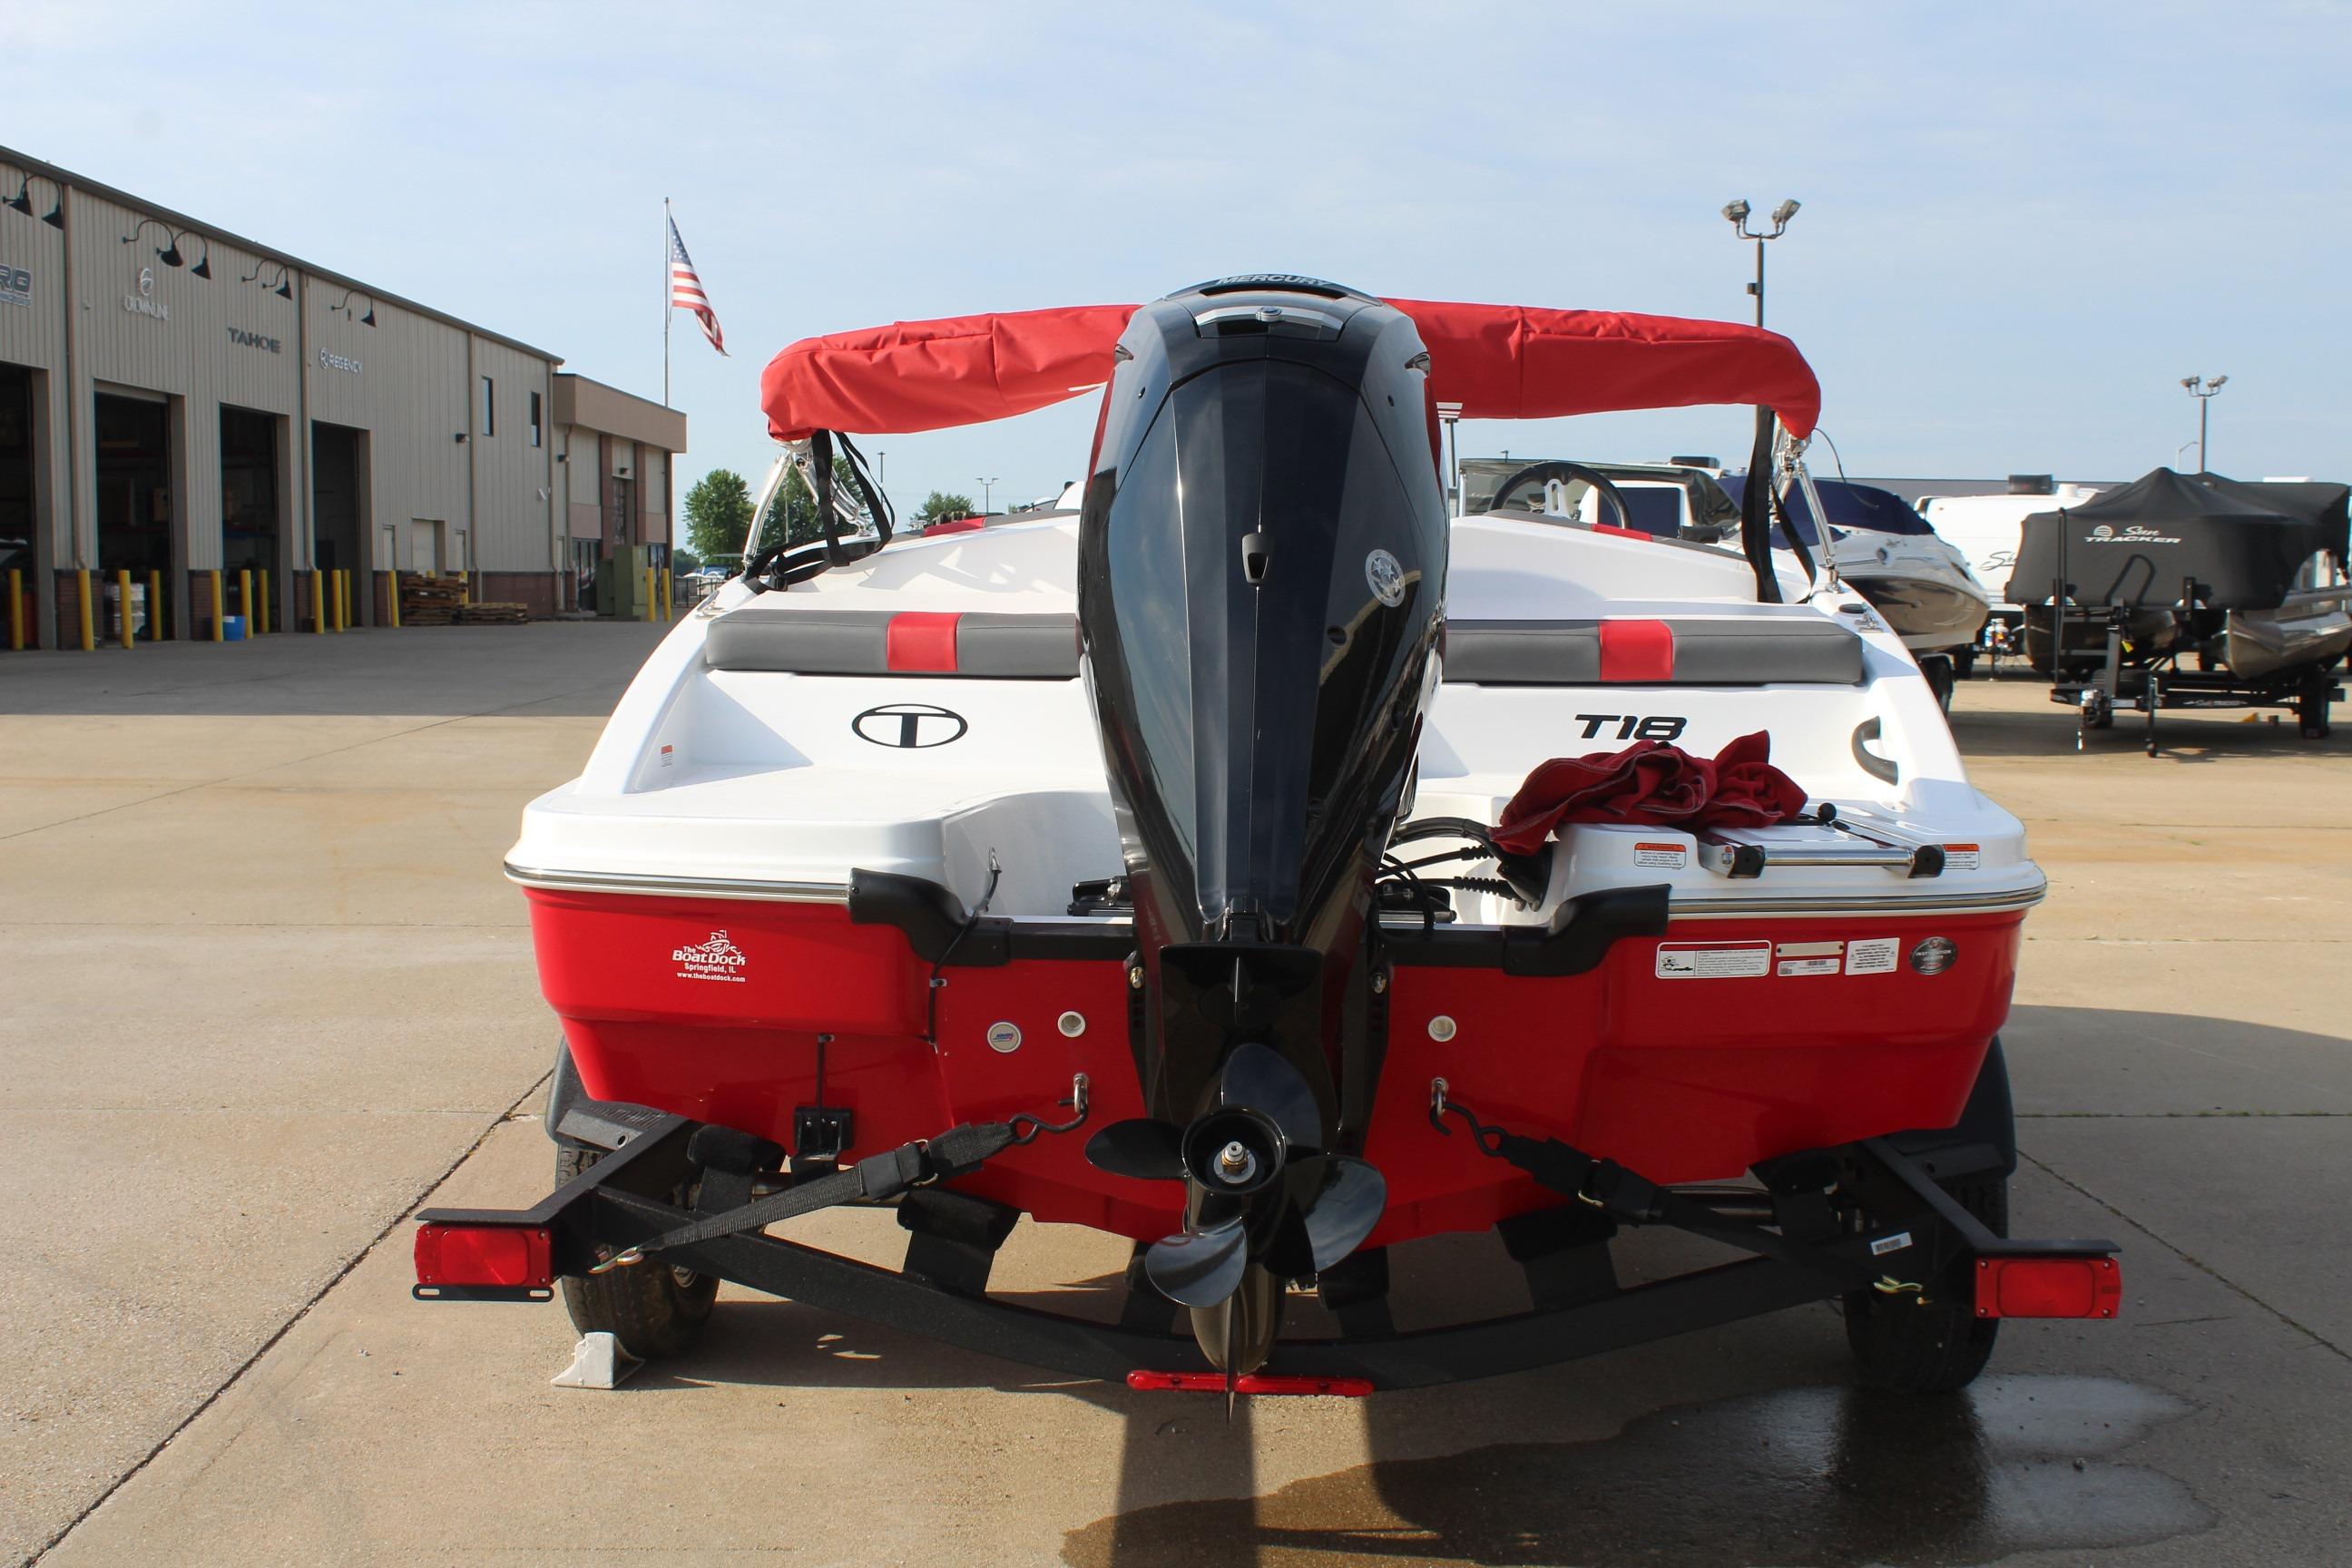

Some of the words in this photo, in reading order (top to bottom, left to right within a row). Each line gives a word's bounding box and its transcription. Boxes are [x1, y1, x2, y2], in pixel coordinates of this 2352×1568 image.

[1216, 274, 1331, 286] MERCURY
[228, 327, 280, 354] TAHOE
[329, 354, 363, 377] REGENCY
[2122, 525, 2160, 536] Sun
[2084, 535, 2181, 544] TRACKER
[1574, 713, 1688, 741] T18
[682, 946, 696, 954] The
[672, 949, 708, 963] Boat
[709, 952, 746, 966] Dock
[684, 963, 727, 974] Springfield,
[729, 965, 736, 974] IL
[676, 972, 746, 983] www.theboatdock.com
